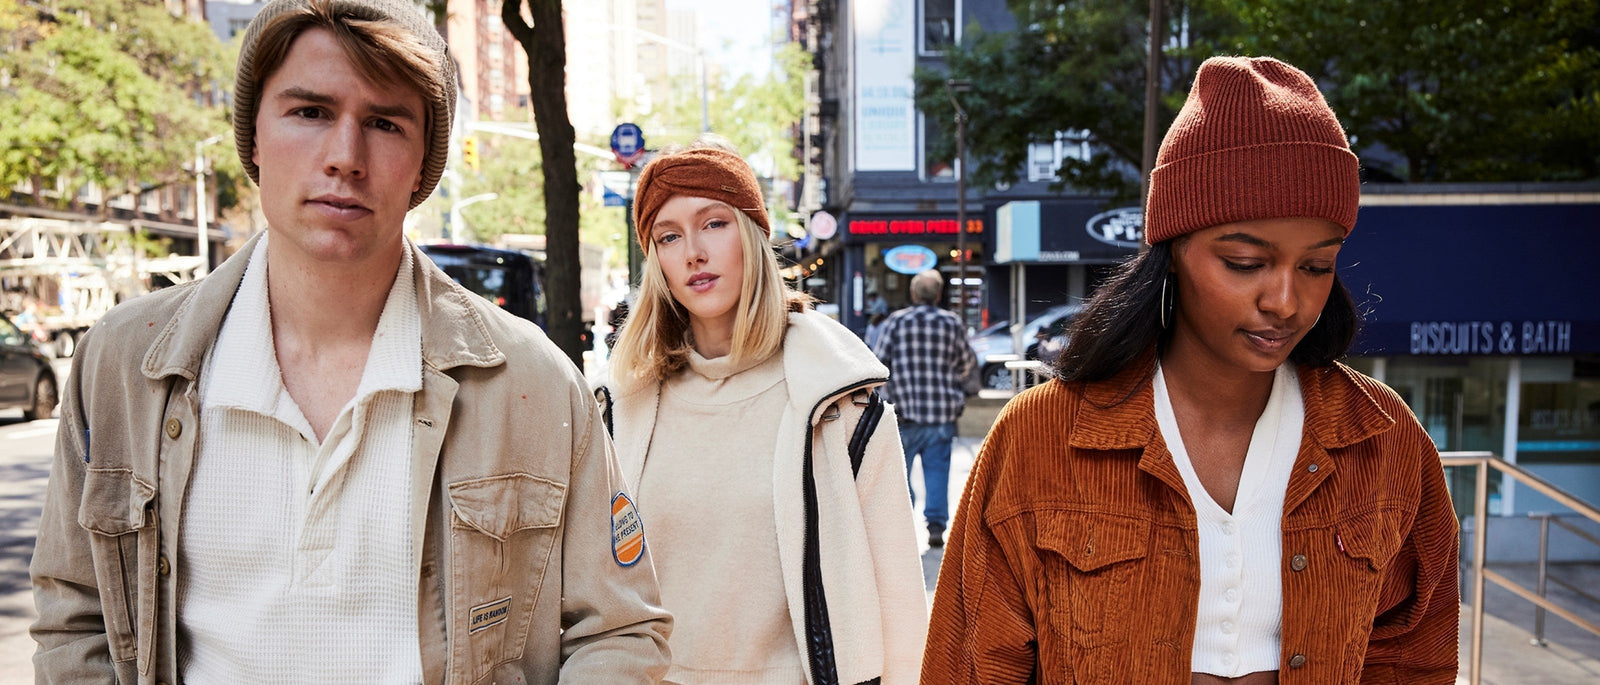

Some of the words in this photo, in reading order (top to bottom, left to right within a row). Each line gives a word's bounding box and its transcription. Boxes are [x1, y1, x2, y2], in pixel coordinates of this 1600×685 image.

[889, 220, 925, 234] OVEN
[1410, 321, 1494, 354] BISCUITS
[1500, 321, 1516, 354] &
[1522, 320, 1572, 354] BATH
[621, 520, 640, 540] PRESENT
[472, 614, 483, 625] LIFE
[484, 612, 489, 621] IS
